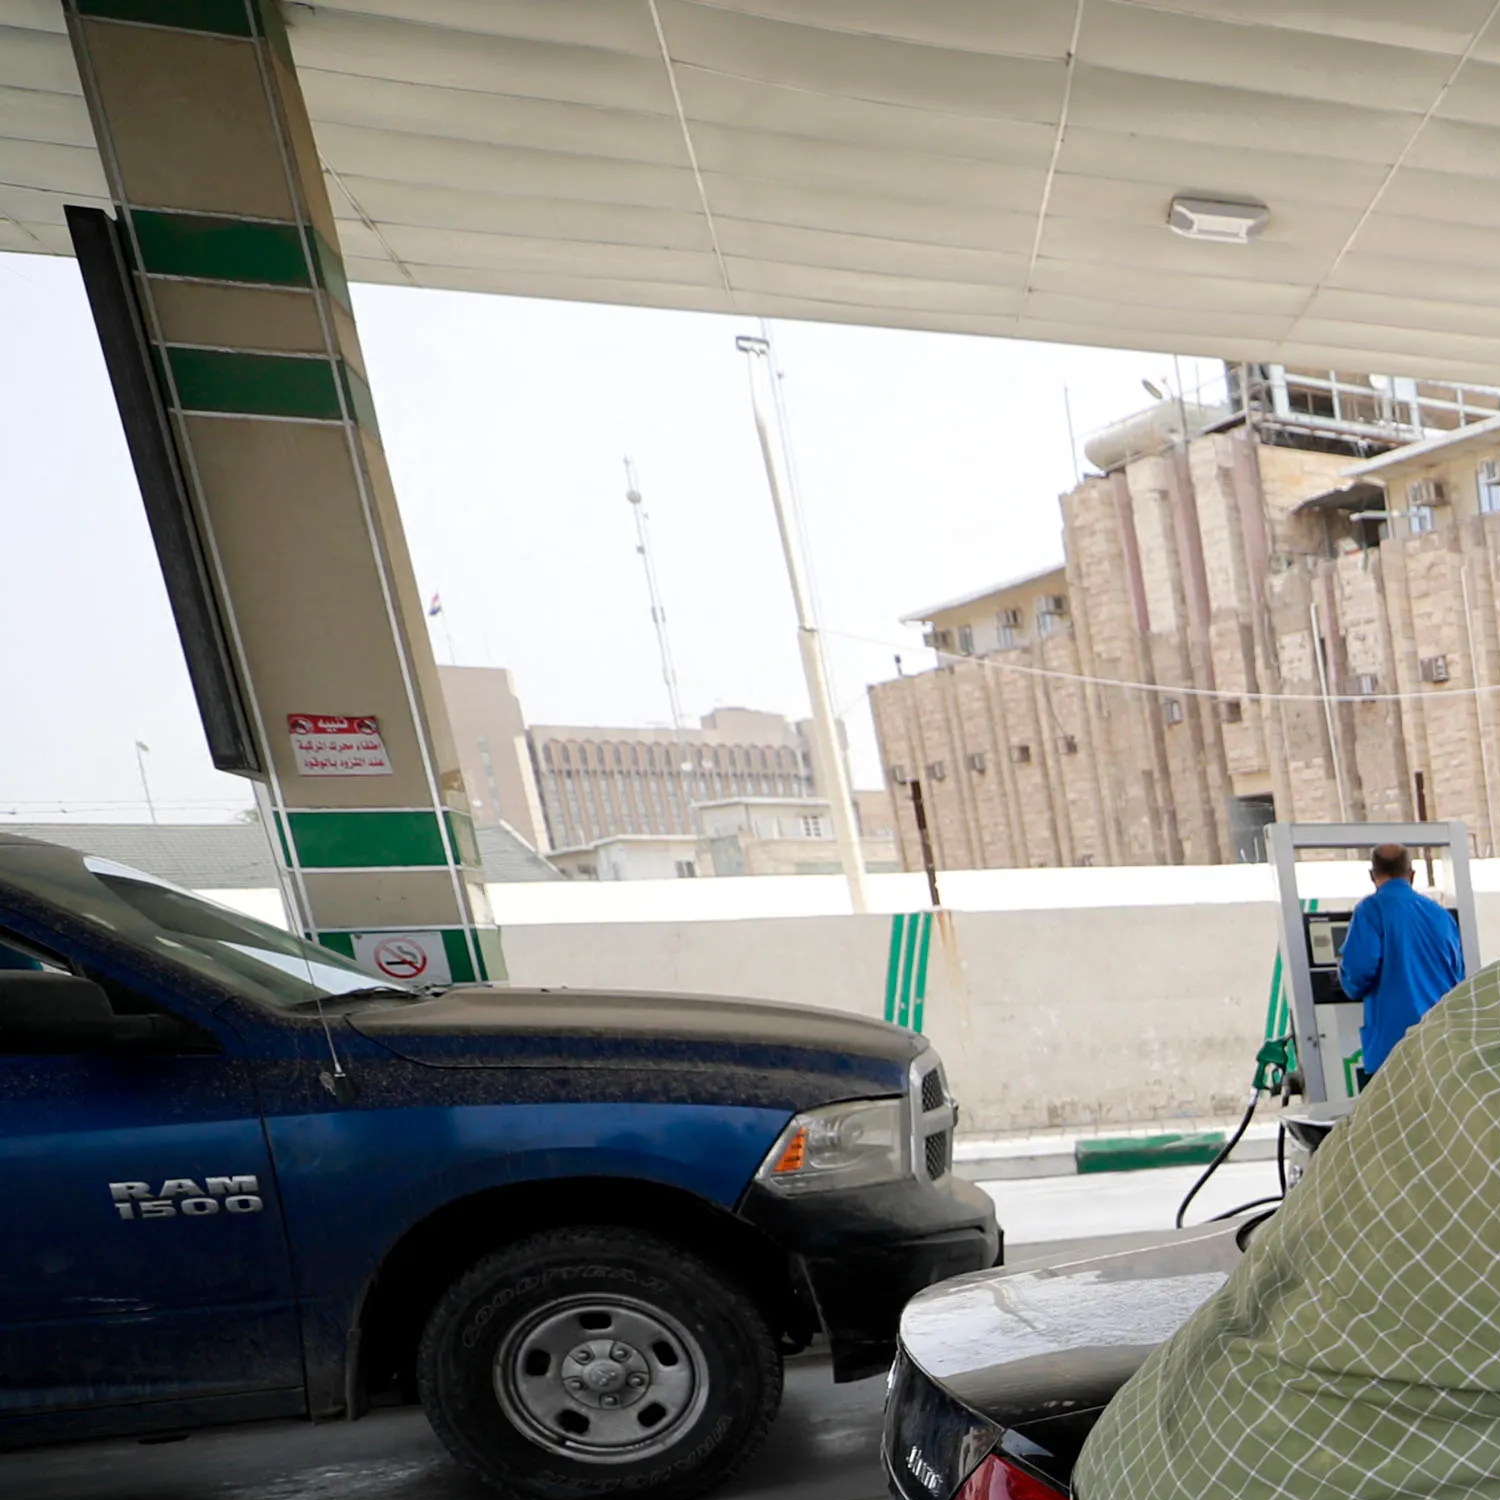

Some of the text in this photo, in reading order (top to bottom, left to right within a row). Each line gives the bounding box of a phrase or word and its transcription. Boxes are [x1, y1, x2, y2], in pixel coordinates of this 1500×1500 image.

[108, 1174, 258, 1201] RAM
[114, 1195, 264, 1220] 1500
[461, 1264, 669, 1349] GOODYEAR
